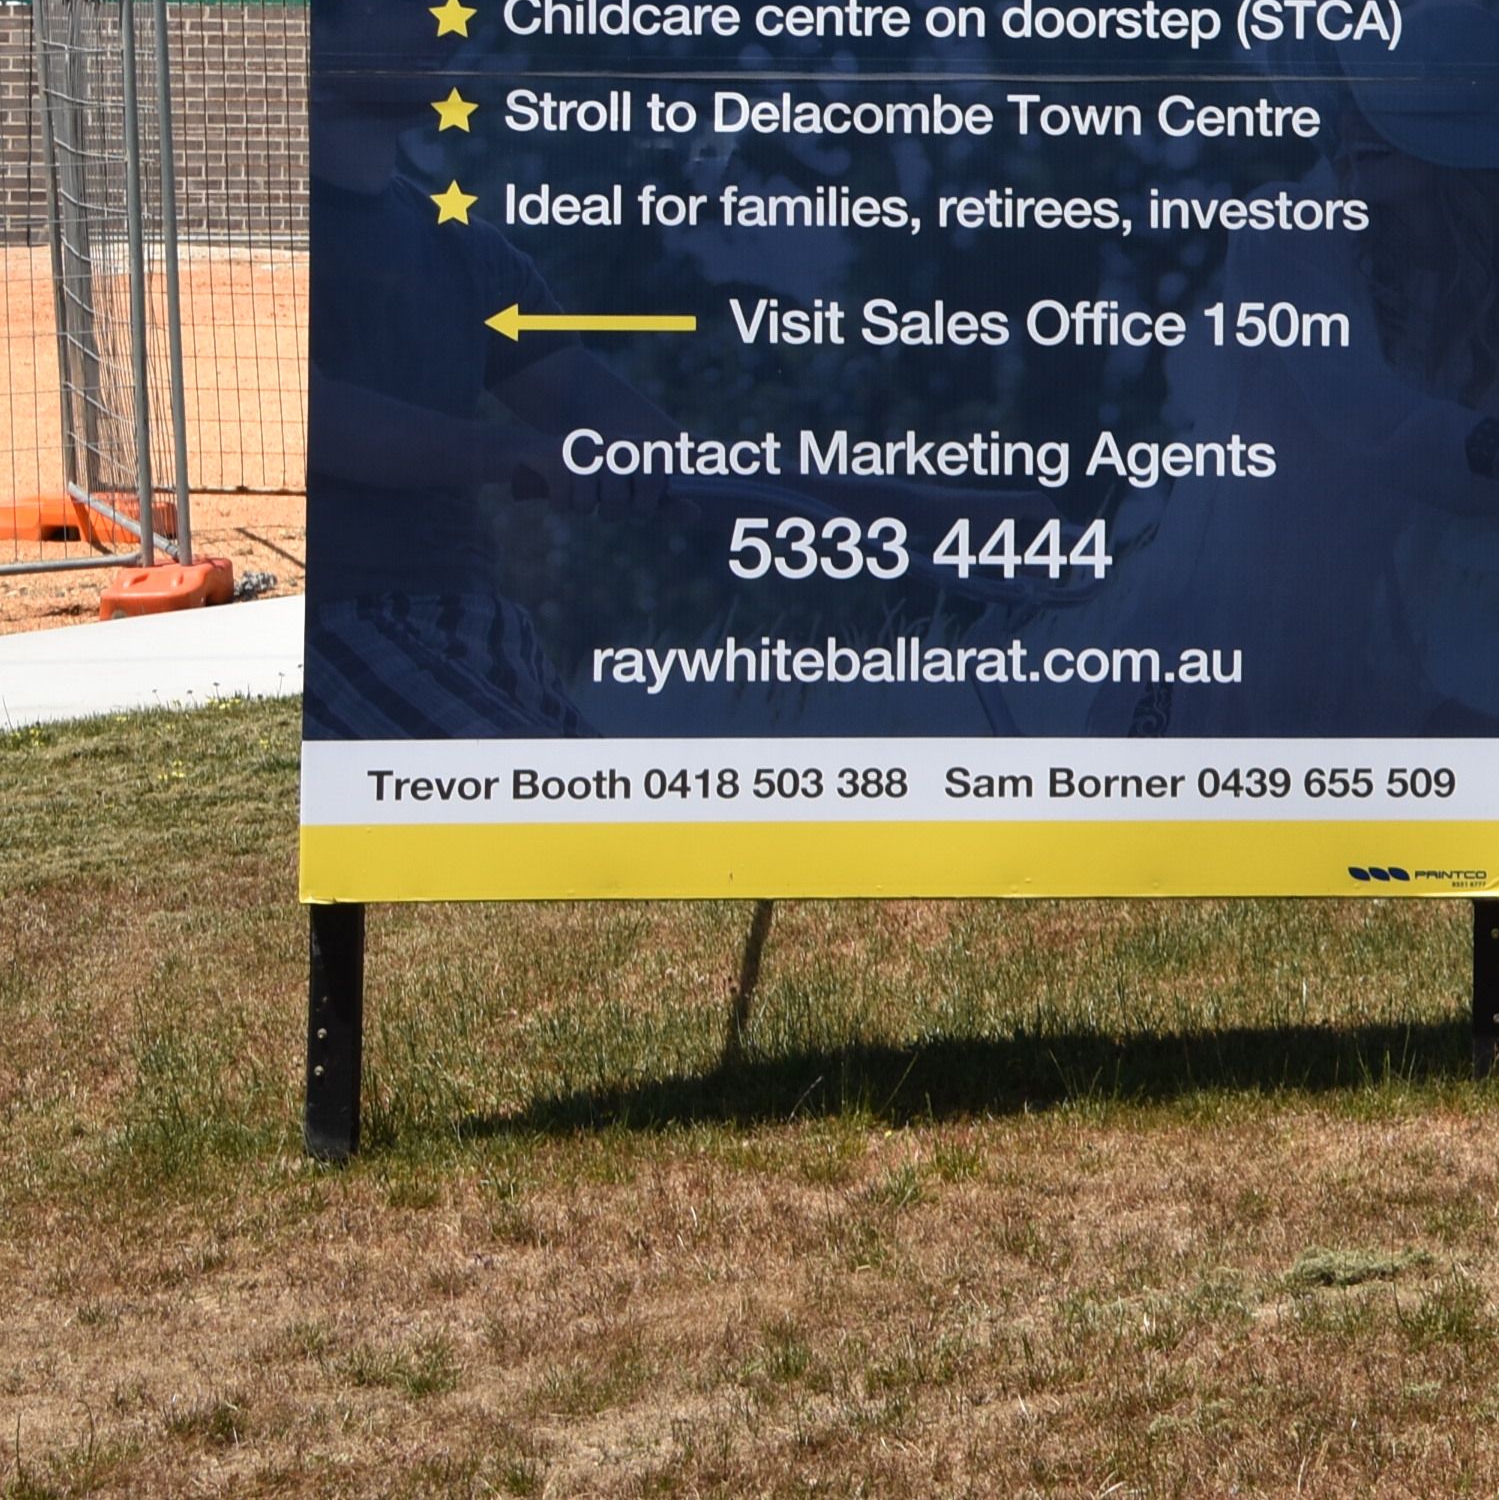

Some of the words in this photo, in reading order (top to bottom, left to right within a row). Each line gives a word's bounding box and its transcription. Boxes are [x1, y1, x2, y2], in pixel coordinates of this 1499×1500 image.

[926, 7, 985, 37] on
[505, 90, 630, 131] Stroll
[647, 94, 696, 132] to
[714, 92, 993, 134] Delacombe
[1007, 95, 1141, 135] Town
[1159, 95, 1320, 137] Centre
[507, 184, 621, 225] Ideal
[638, 185, 707, 226] for
[720, 186, 922, 234] families,
[940, 188, 1133, 236] retirees,
[1151, 189, 1369, 230] investors
[730, 299, 844, 344] Visit
[862, 299, 1009, 345] Sales
[1027, 300, 1186, 346] Office
[1205, 302, 1349, 347] 150m
[563, 429, 780, 474] Contact
[801, 431, 1068, 487] Marketing
[1086, 432, 1276, 488] Agents
[729, 518, 909, 578] 5333
[933, 519, 1112, 578] 4444
[594, 637, 1243, 694] raywhiteballarat.com.au
[368, 770, 499, 800] Trevor
[513, 769, 630, 799] Booth
[645, 769, 739, 798] 0418
[754, 769, 823, 798] 503
[838, 768, 907, 797] 388
[946, 768, 1032, 797] Sam
[1050, 768, 1185, 797] Borner
[1198, 768, 1290, 797] 0439
[1305, 768, 1373, 797] 655
[1387, 768, 1455, 797] 509
[1415, 870, 1487, 879] PRINTCO
